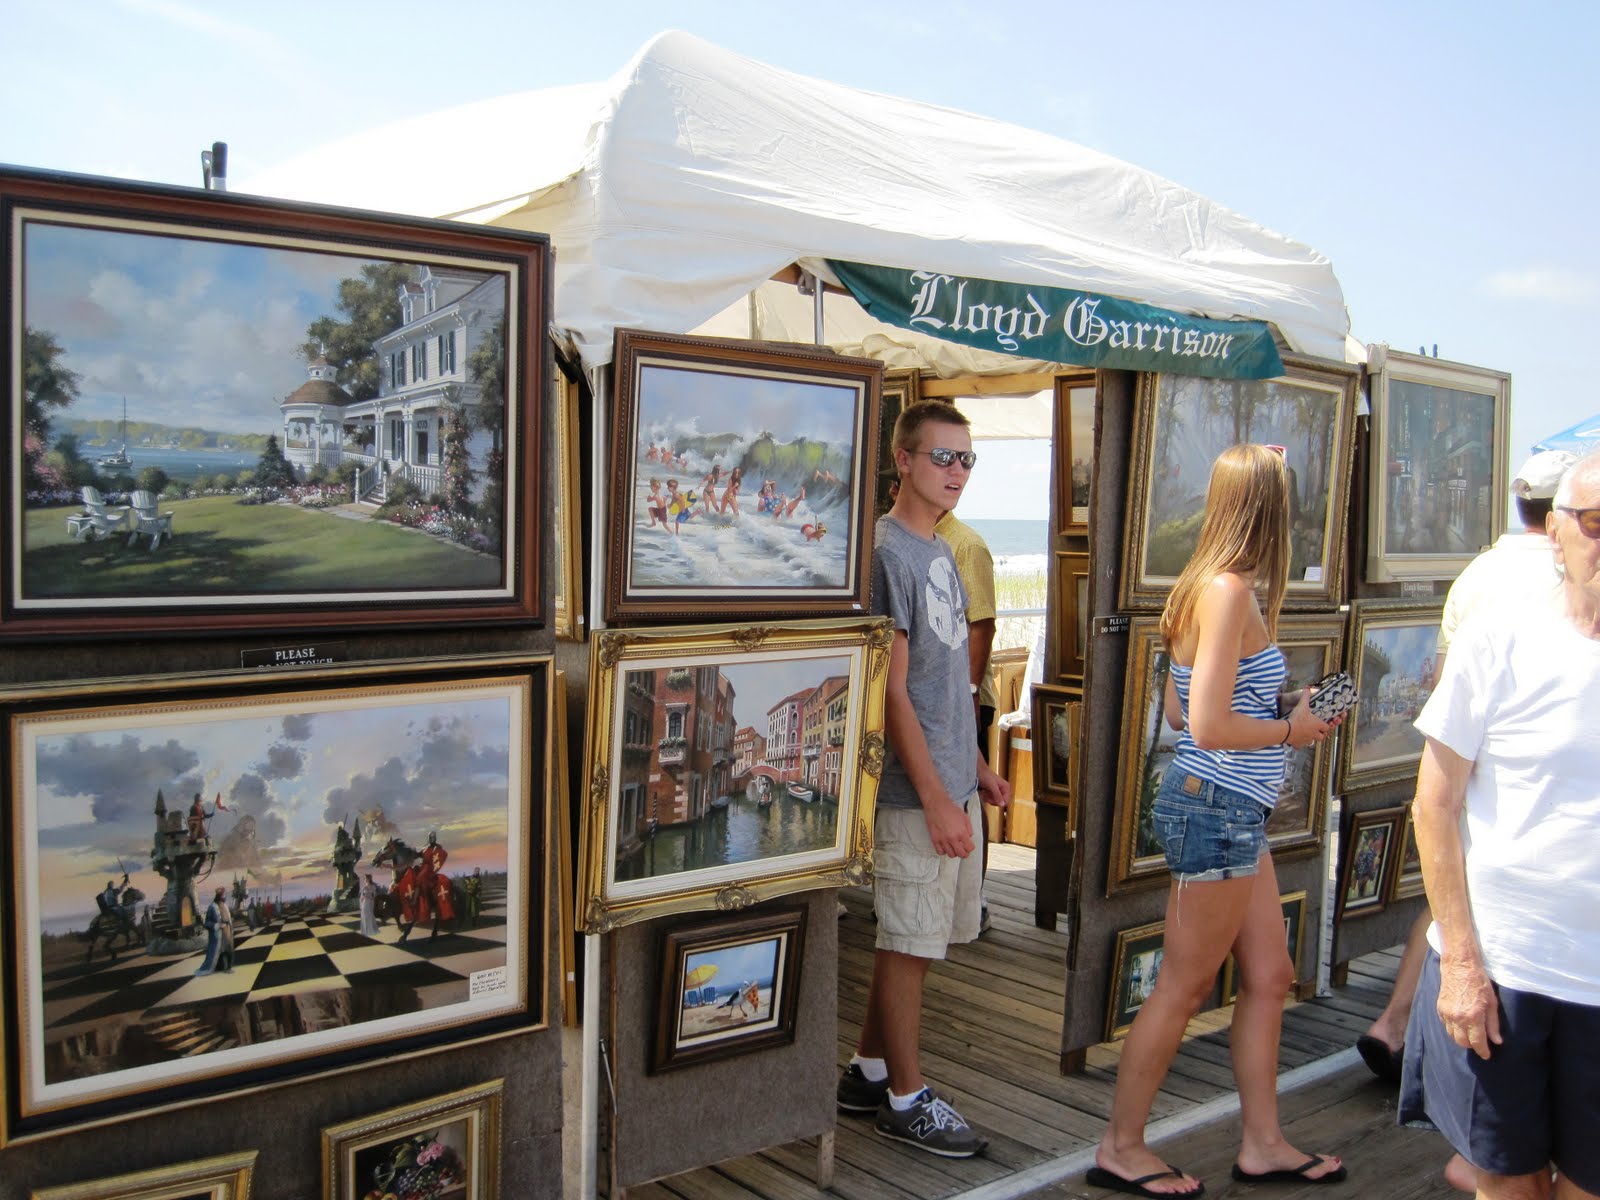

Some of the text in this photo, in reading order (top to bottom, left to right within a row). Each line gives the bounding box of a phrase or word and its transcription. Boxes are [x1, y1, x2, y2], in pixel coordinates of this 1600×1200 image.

[909, 271, 1235, 360] Lloyd Garrison
[1109, 617, 1129, 625] PLEASE
[275, 648, 315, 660] PLEASE
[908, 1116, 937, 1139] N
